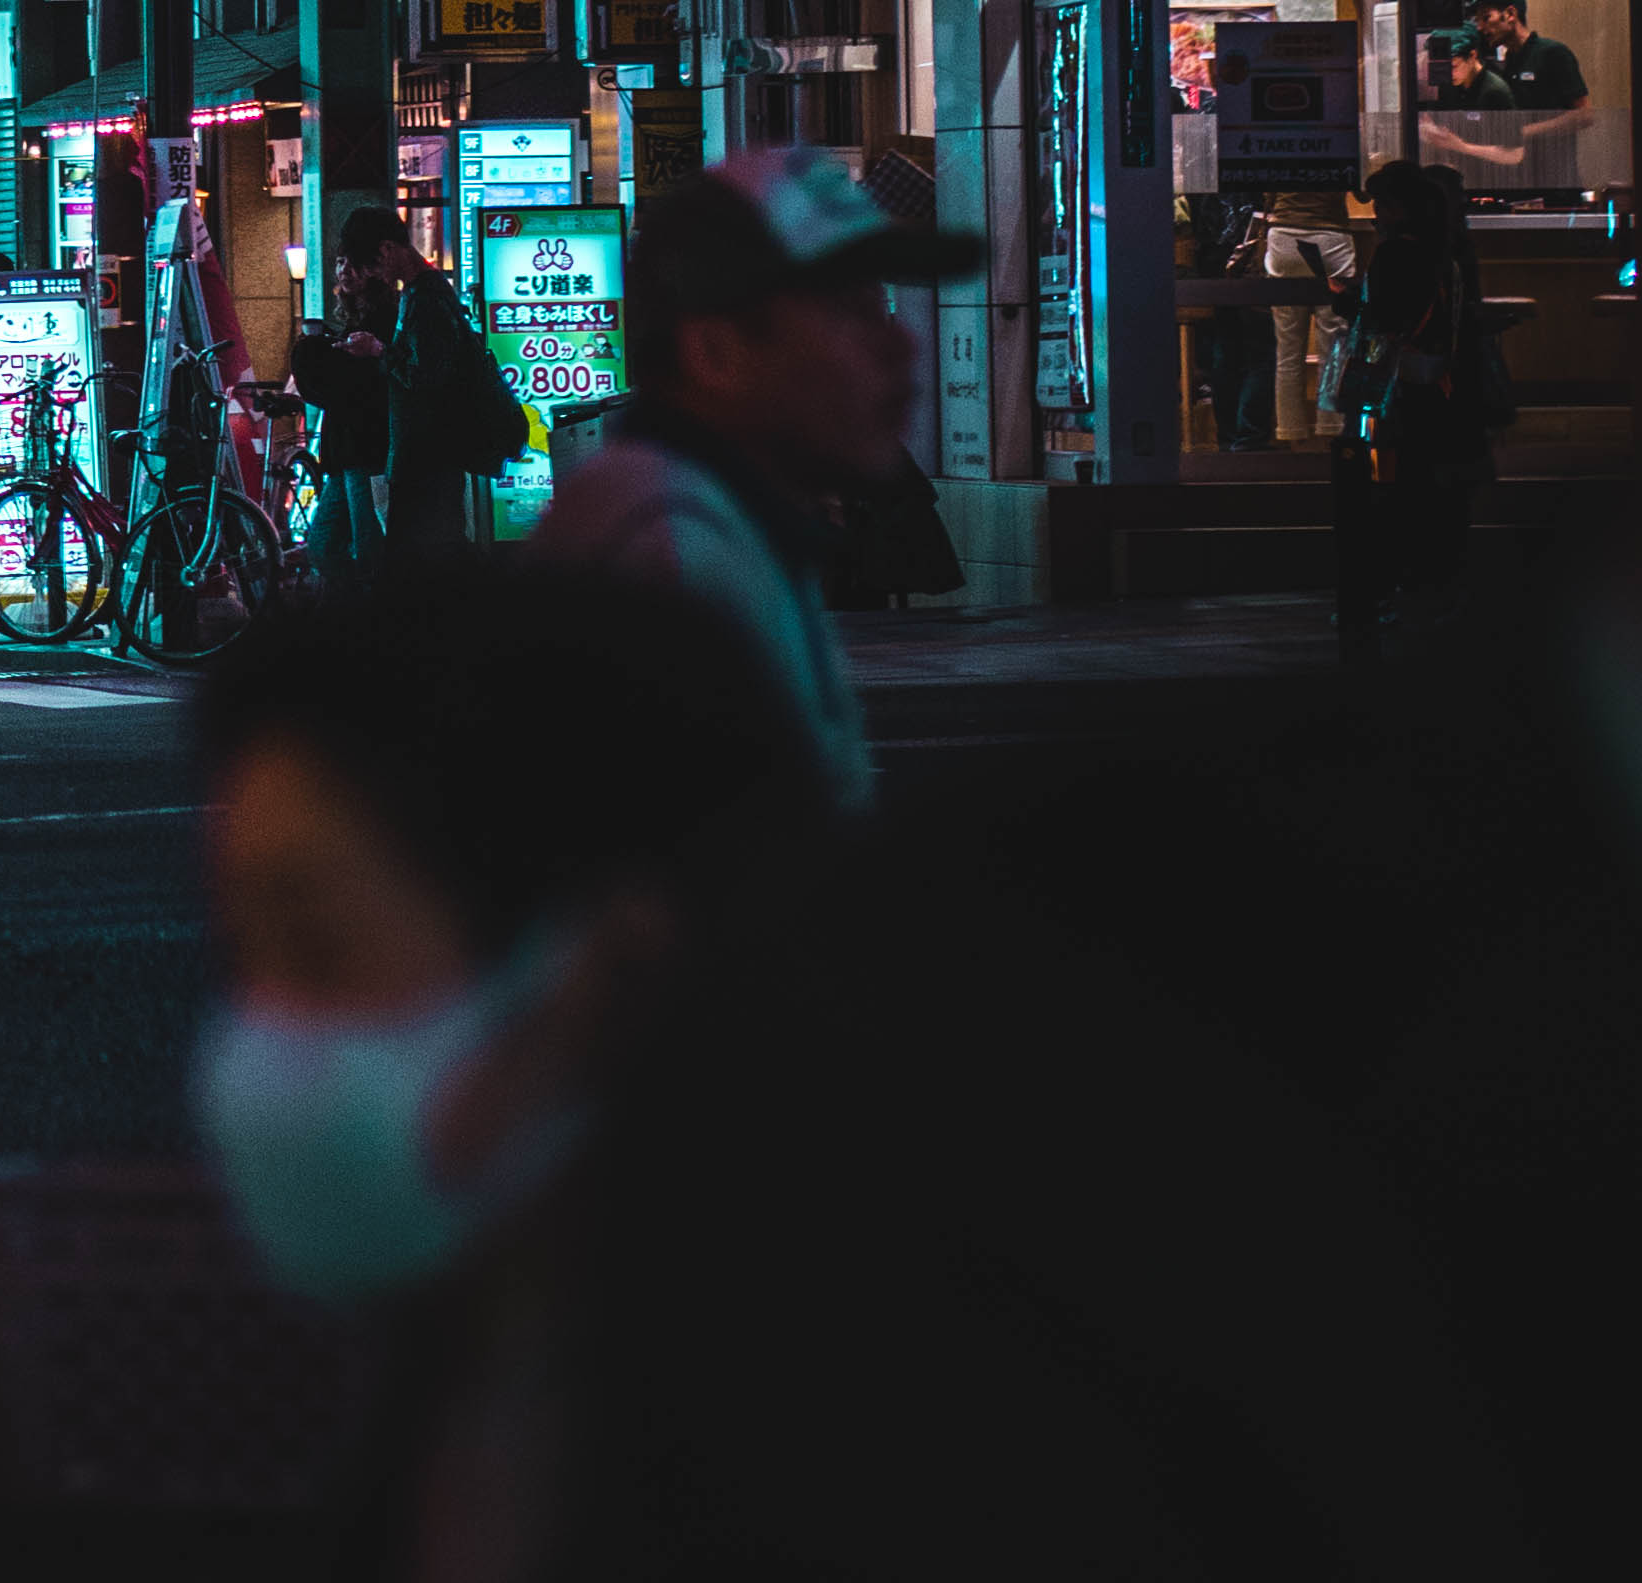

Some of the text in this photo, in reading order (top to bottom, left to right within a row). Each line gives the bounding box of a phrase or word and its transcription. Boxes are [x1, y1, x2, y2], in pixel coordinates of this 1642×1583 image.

[1257, 138, 1332, 152] TAKE OUT
[488, 216, 512, 232] 4F
[514, 274, 594, 296] こり道楽
[495, 304, 614, 325] 全身もみほぐし
[520, 336, 575, 360] 60分
